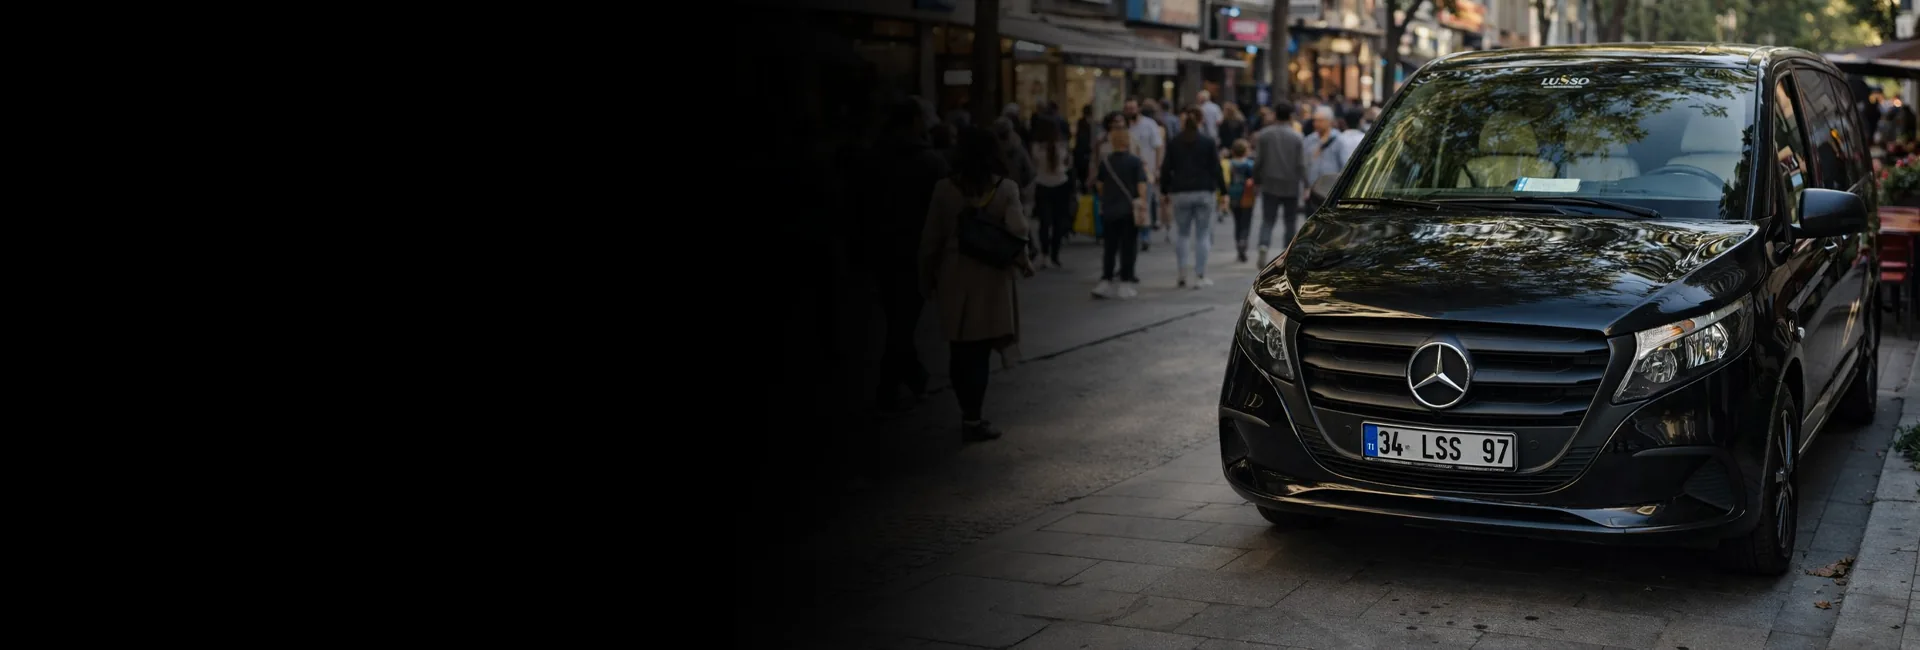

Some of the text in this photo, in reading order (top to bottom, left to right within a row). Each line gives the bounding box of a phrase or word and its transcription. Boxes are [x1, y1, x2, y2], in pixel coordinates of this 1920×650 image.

[1541, 74, 1590, 85] LUSSO
[1379, 430, 1510, 464] 34 LSS 97
